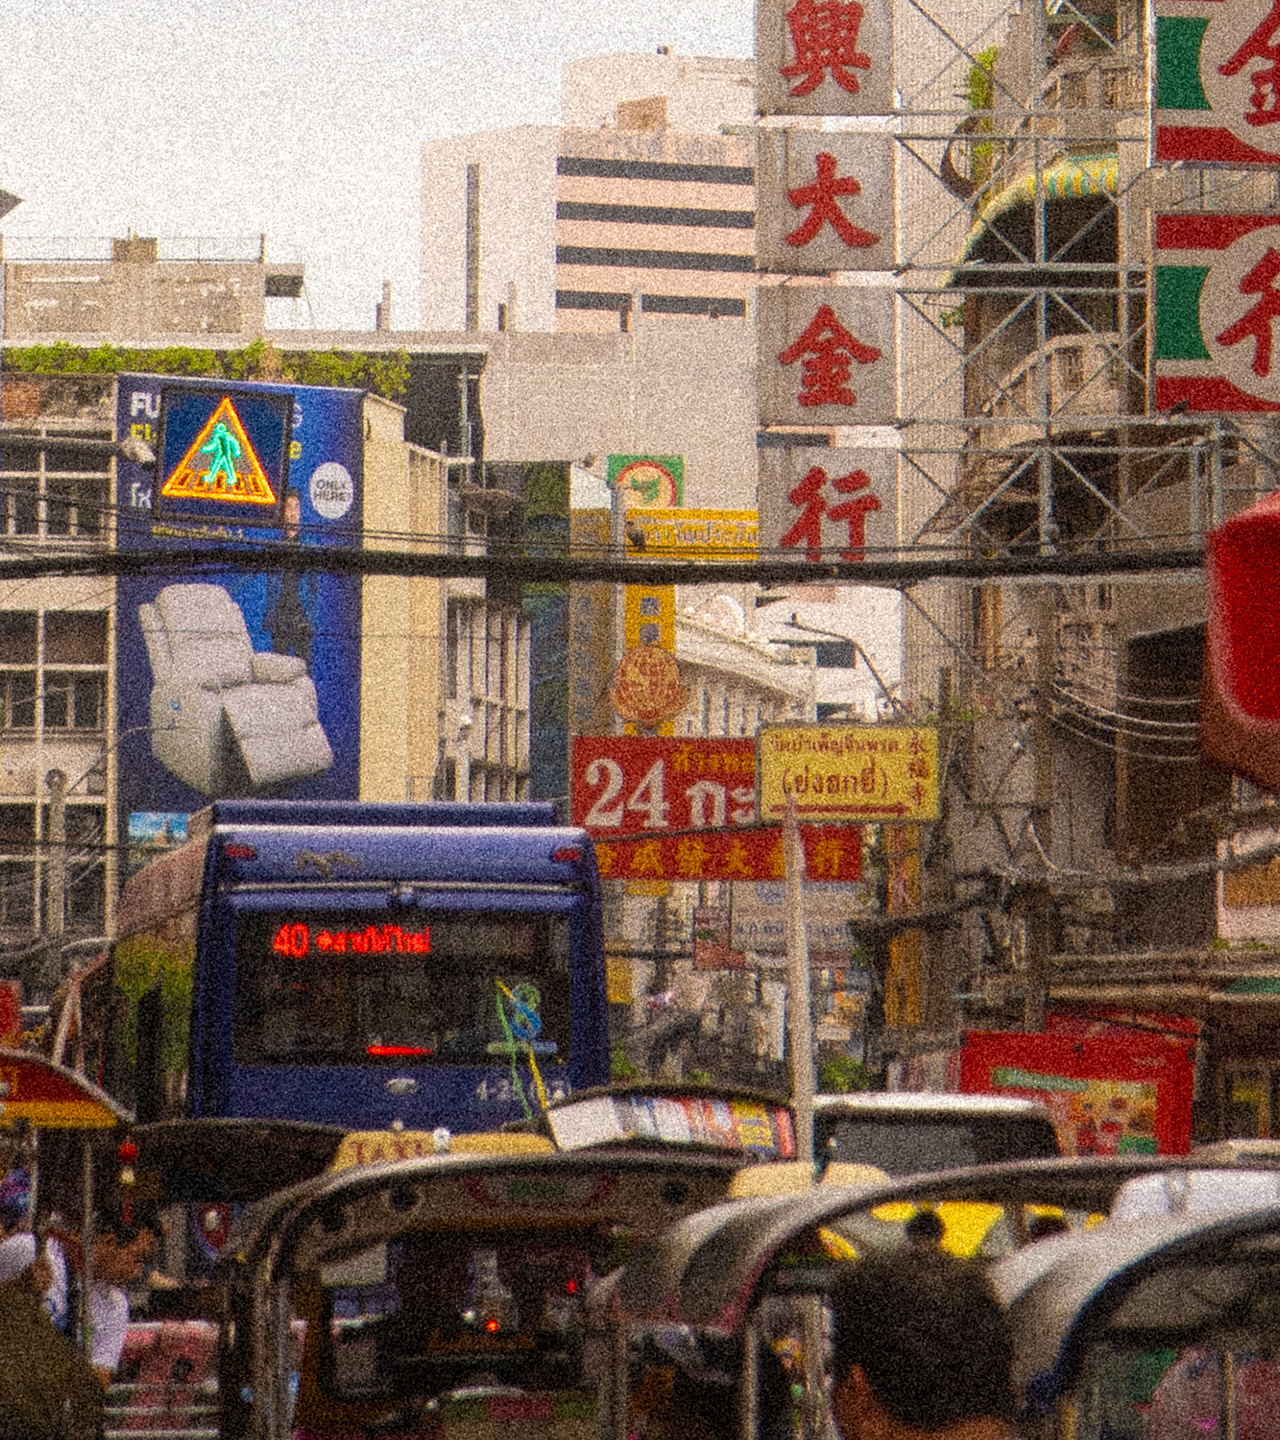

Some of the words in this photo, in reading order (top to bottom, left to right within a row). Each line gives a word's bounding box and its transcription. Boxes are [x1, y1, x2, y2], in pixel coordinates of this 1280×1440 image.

[670, 743, 756, 774] ห้างทอ
[584, 757, 669, 828] 24
[684, 778, 756, 828] กะ
[272, 922, 310, 958] 40
